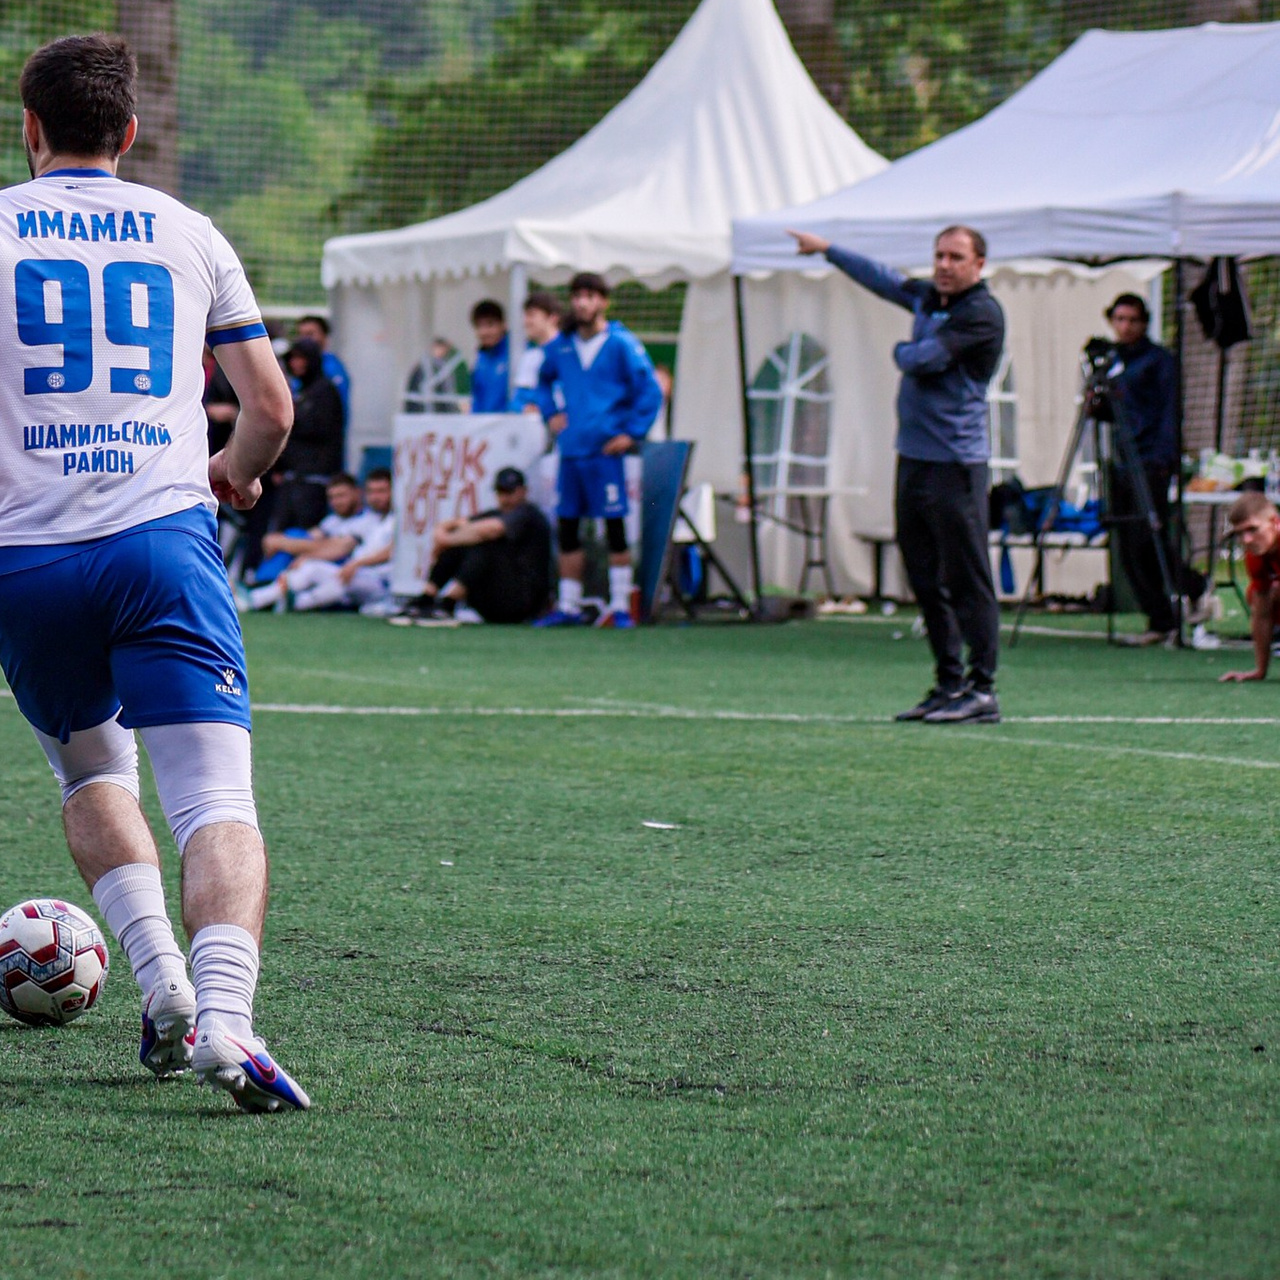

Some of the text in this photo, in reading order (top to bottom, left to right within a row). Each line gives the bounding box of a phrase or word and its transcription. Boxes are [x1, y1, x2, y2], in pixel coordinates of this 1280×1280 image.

[16, 210, 156, 243] ИМАМАТ
[15, 259, 174, 398] 99
[23, 420, 172, 451] ШАМИЛЬСКИЙ
[63, 446, 134, 476] РАЙОН
